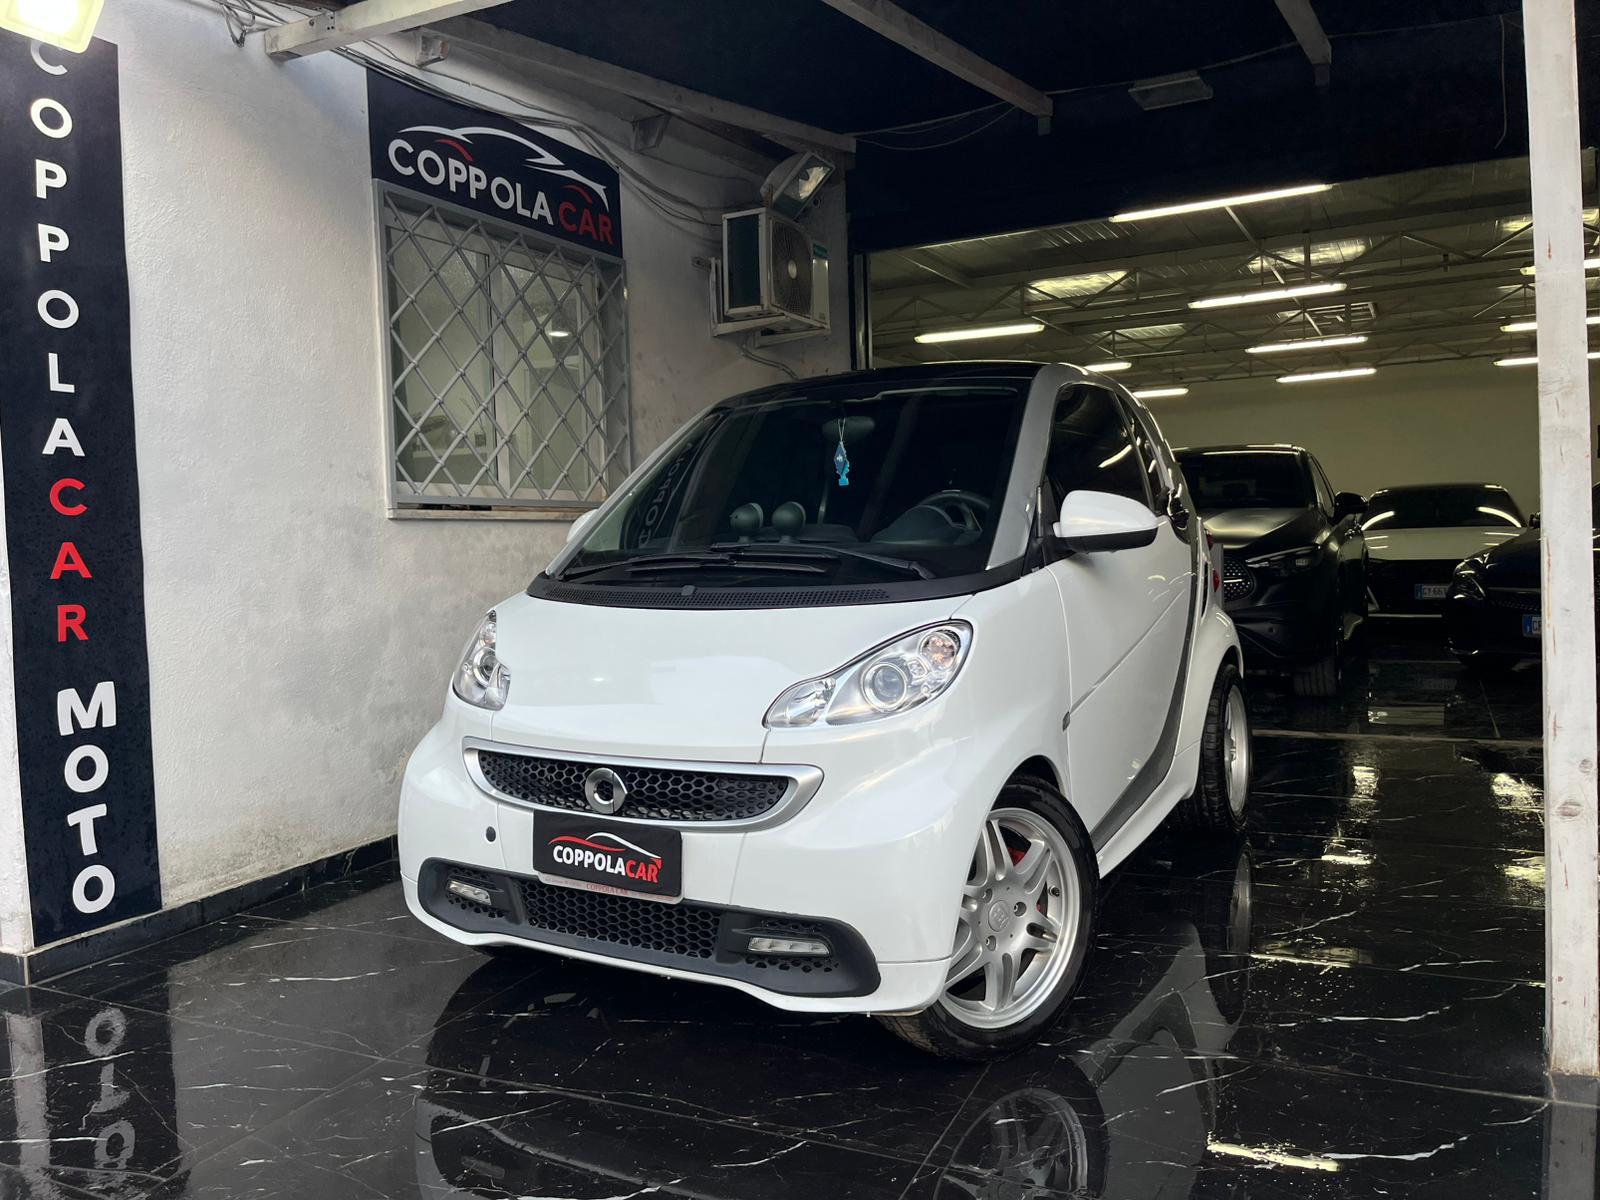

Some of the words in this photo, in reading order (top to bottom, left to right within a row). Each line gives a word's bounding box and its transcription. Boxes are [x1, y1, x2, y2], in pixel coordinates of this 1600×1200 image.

[388, 138, 554, 226] COPPOLA
[558, 201, 614, 246] CAR
[49, 478, 92, 643] CAR
[57, 681, 117, 914] MOTO
